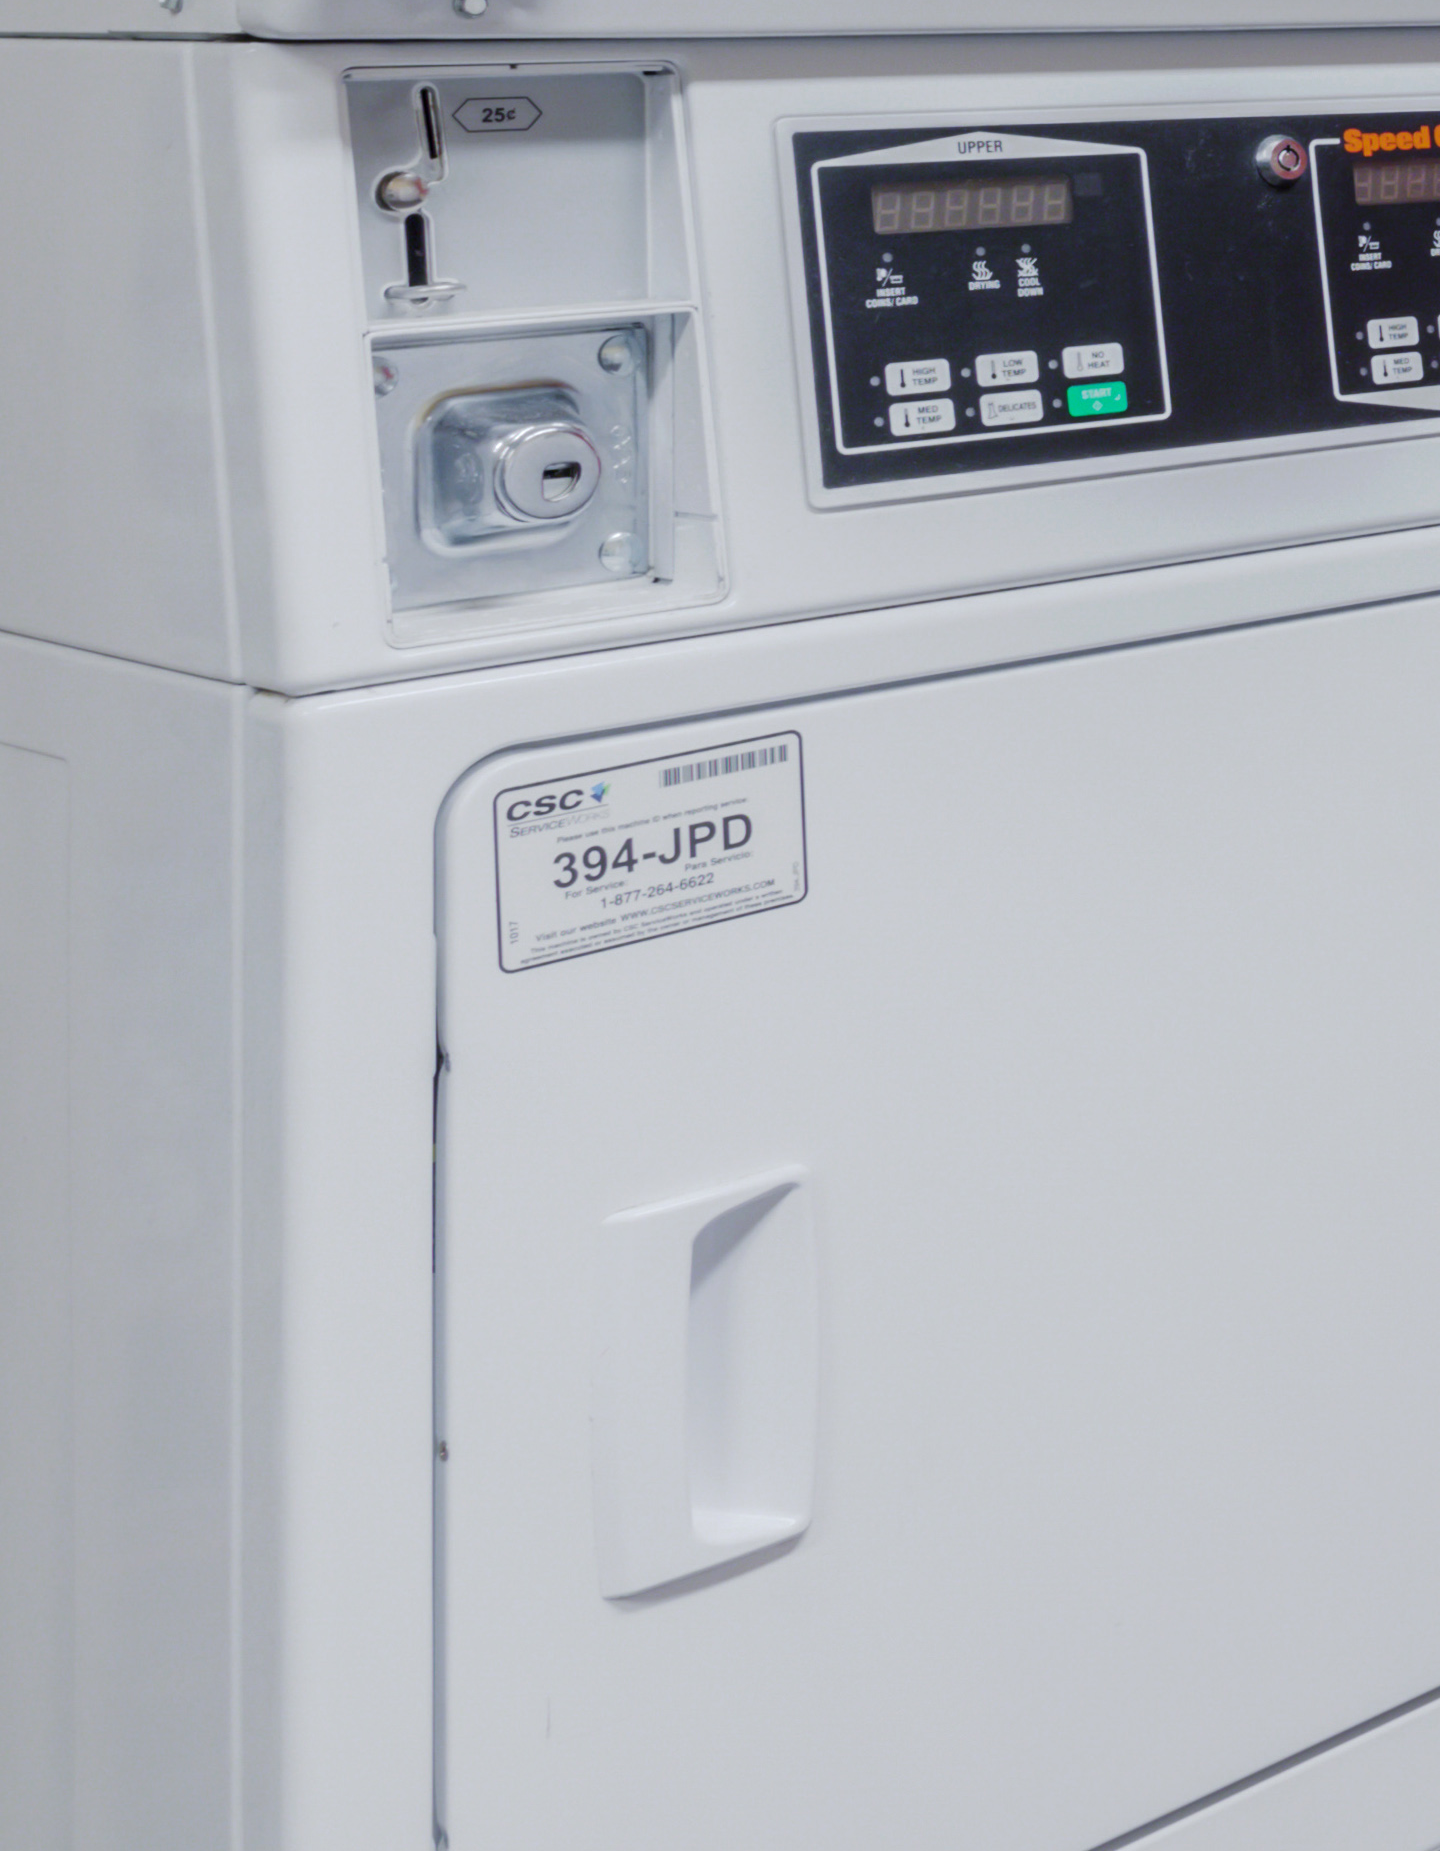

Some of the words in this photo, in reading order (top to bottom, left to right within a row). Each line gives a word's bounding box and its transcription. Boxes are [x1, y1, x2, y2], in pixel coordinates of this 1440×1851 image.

[482, 104, 517, 123] 25¢
[1344, 125, 1431, 156] Speed
[957, 140, 1003, 154] UPPER
[968, 280, 1000, 290] DRYING
[1018, 278, 1040, 287] COOL
[876, 287, 906, 297] INSERT
[1017, 287, 1044, 297] DOWN
[896, 296, 918, 307] CARD
[1388, 323, 1408, 332] HIGH
[1388, 332, 1410, 340] TEMP
[1091, 351, 1105, 359] NO
[1002, 358, 1023, 368] LOW
[1088, 359, 1110, 369] HEAT
[1393, 357, 1410, 366] MED
[912, 366, 936, 376] HIGH
[1002, 368, 1026, 378] TEMP
[1393, 365, 1413, 375] TEMP
[912, 375, 939, 386] TEMP
[1081, 387, 1113, 399] START
[917, 405, 939, 414] MED
[998, 401, 1037, 413] DELICATES
[916, 413, 942, 424] TEMP
[506, 789, 584, 821] CSC
[553, 814, 751, 889] 394-JPD
[685, 861, 707, 872] Para
[565, 890, 583, 900] For
[601, 873, 714, 908] 1-877-264-6622
[535, 931, 557, 941] Visit
[559, 927, 576, 936] our
[579, 918, 616, 931] website
[620, 879, 775, 920] WWW.CSCSERVICEWORKS.COM
[509, 921, 519, 944] 1017
